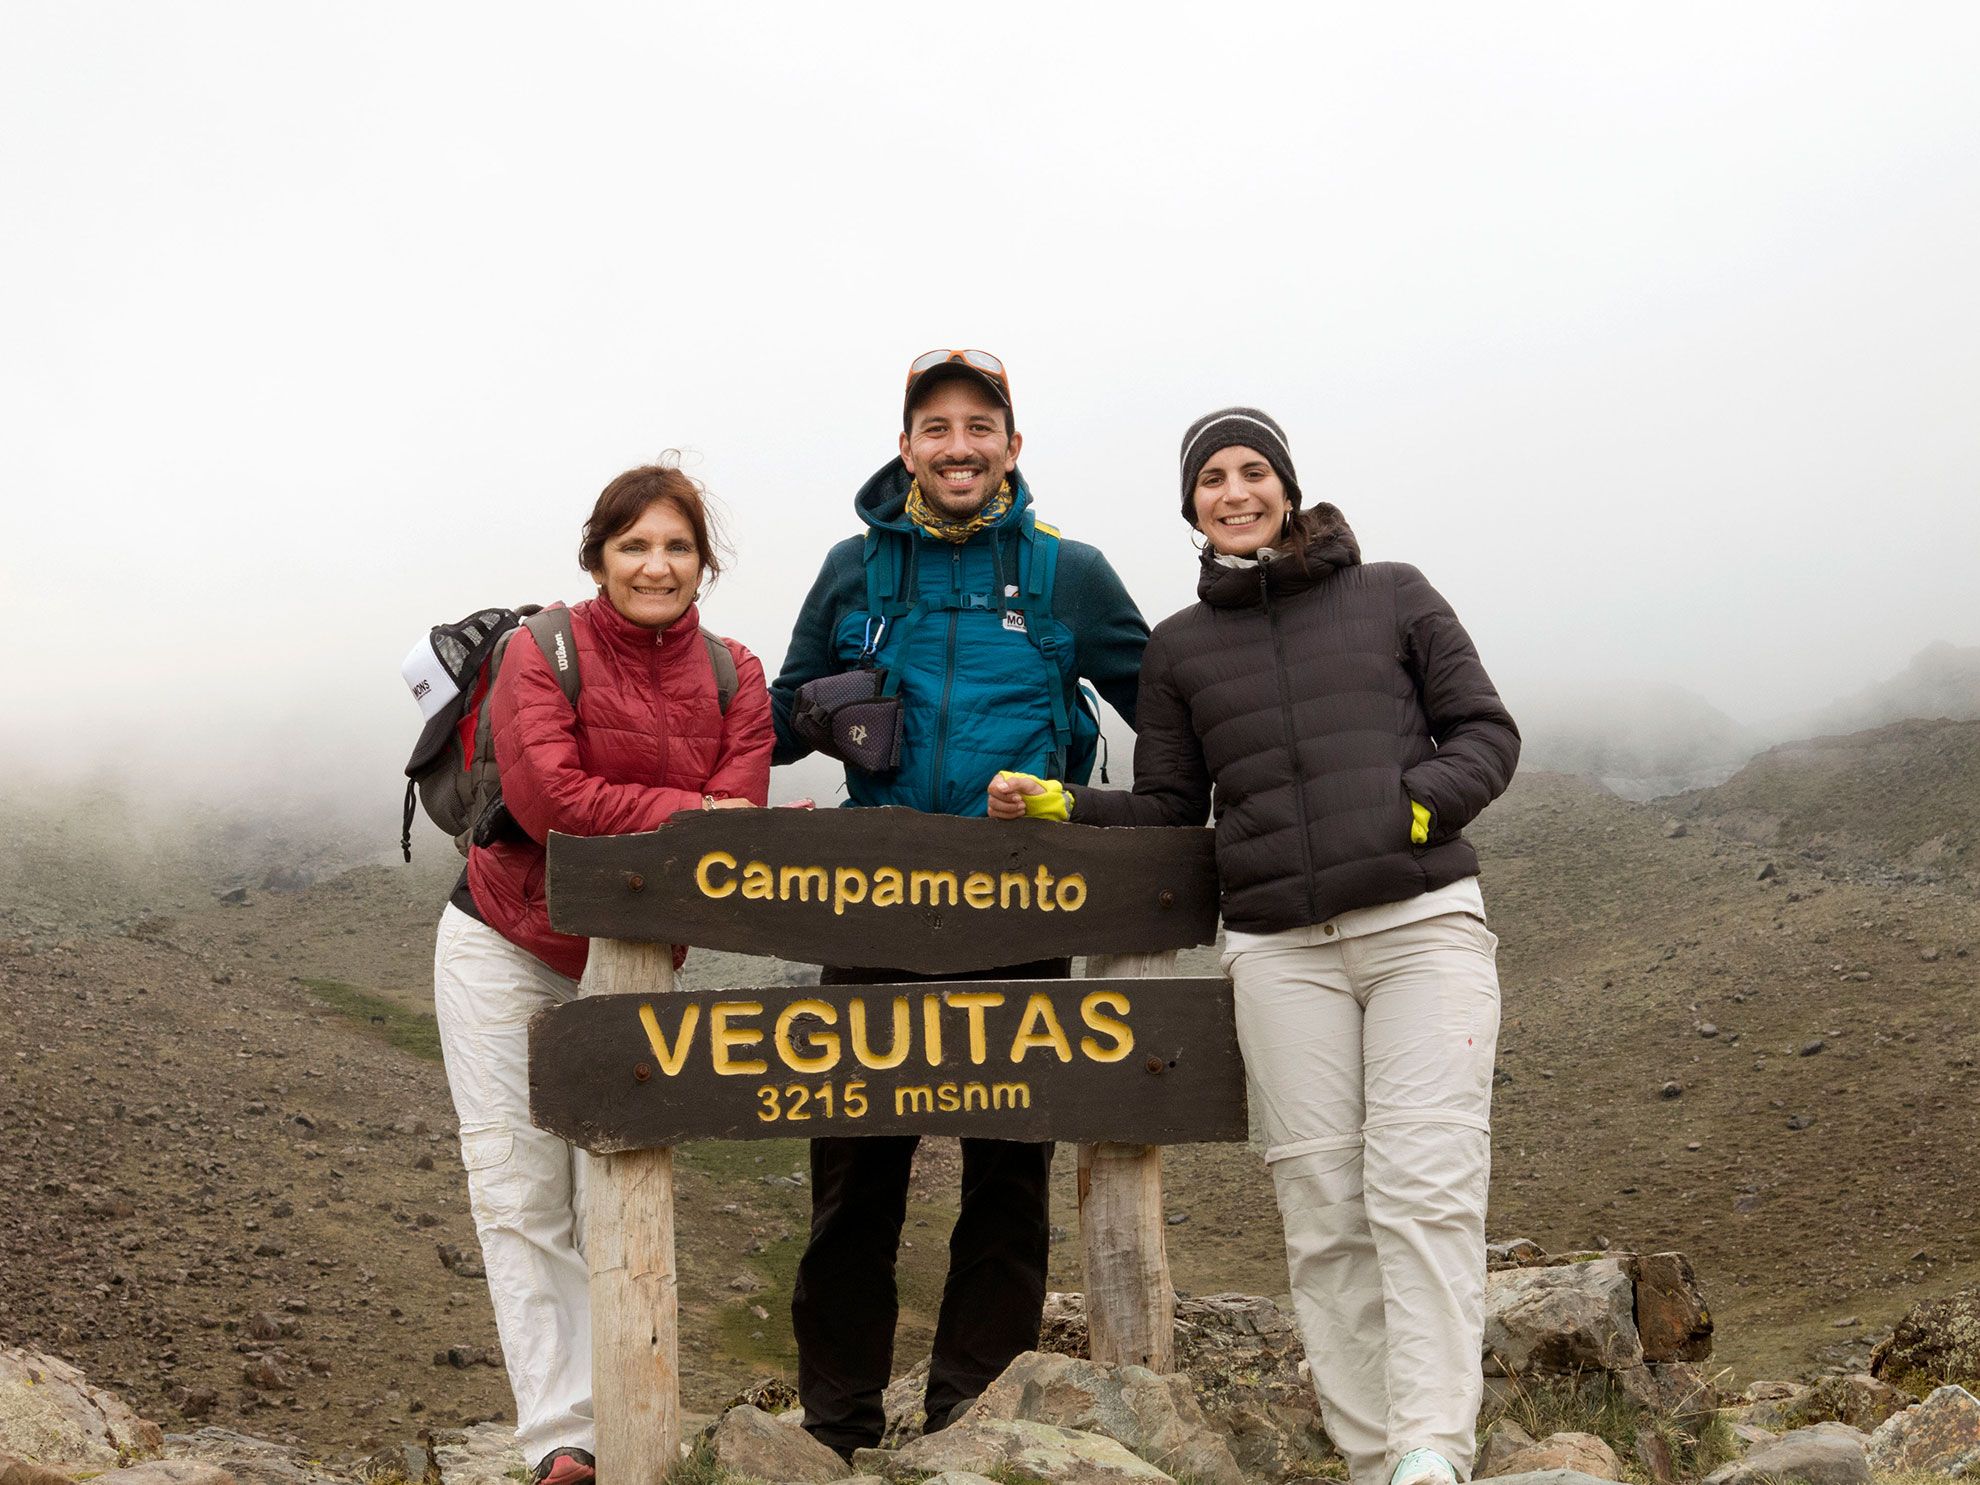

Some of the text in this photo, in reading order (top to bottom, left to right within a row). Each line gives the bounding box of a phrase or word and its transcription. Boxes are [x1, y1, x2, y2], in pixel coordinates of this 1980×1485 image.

[1007, 615, 1024, 626] MO
[695, 851, 1087, 915] Campamento
[638, 992, 1135, 1076] VEGUITAS
[757, 1080, 1031, 1122] 3215 msnm
